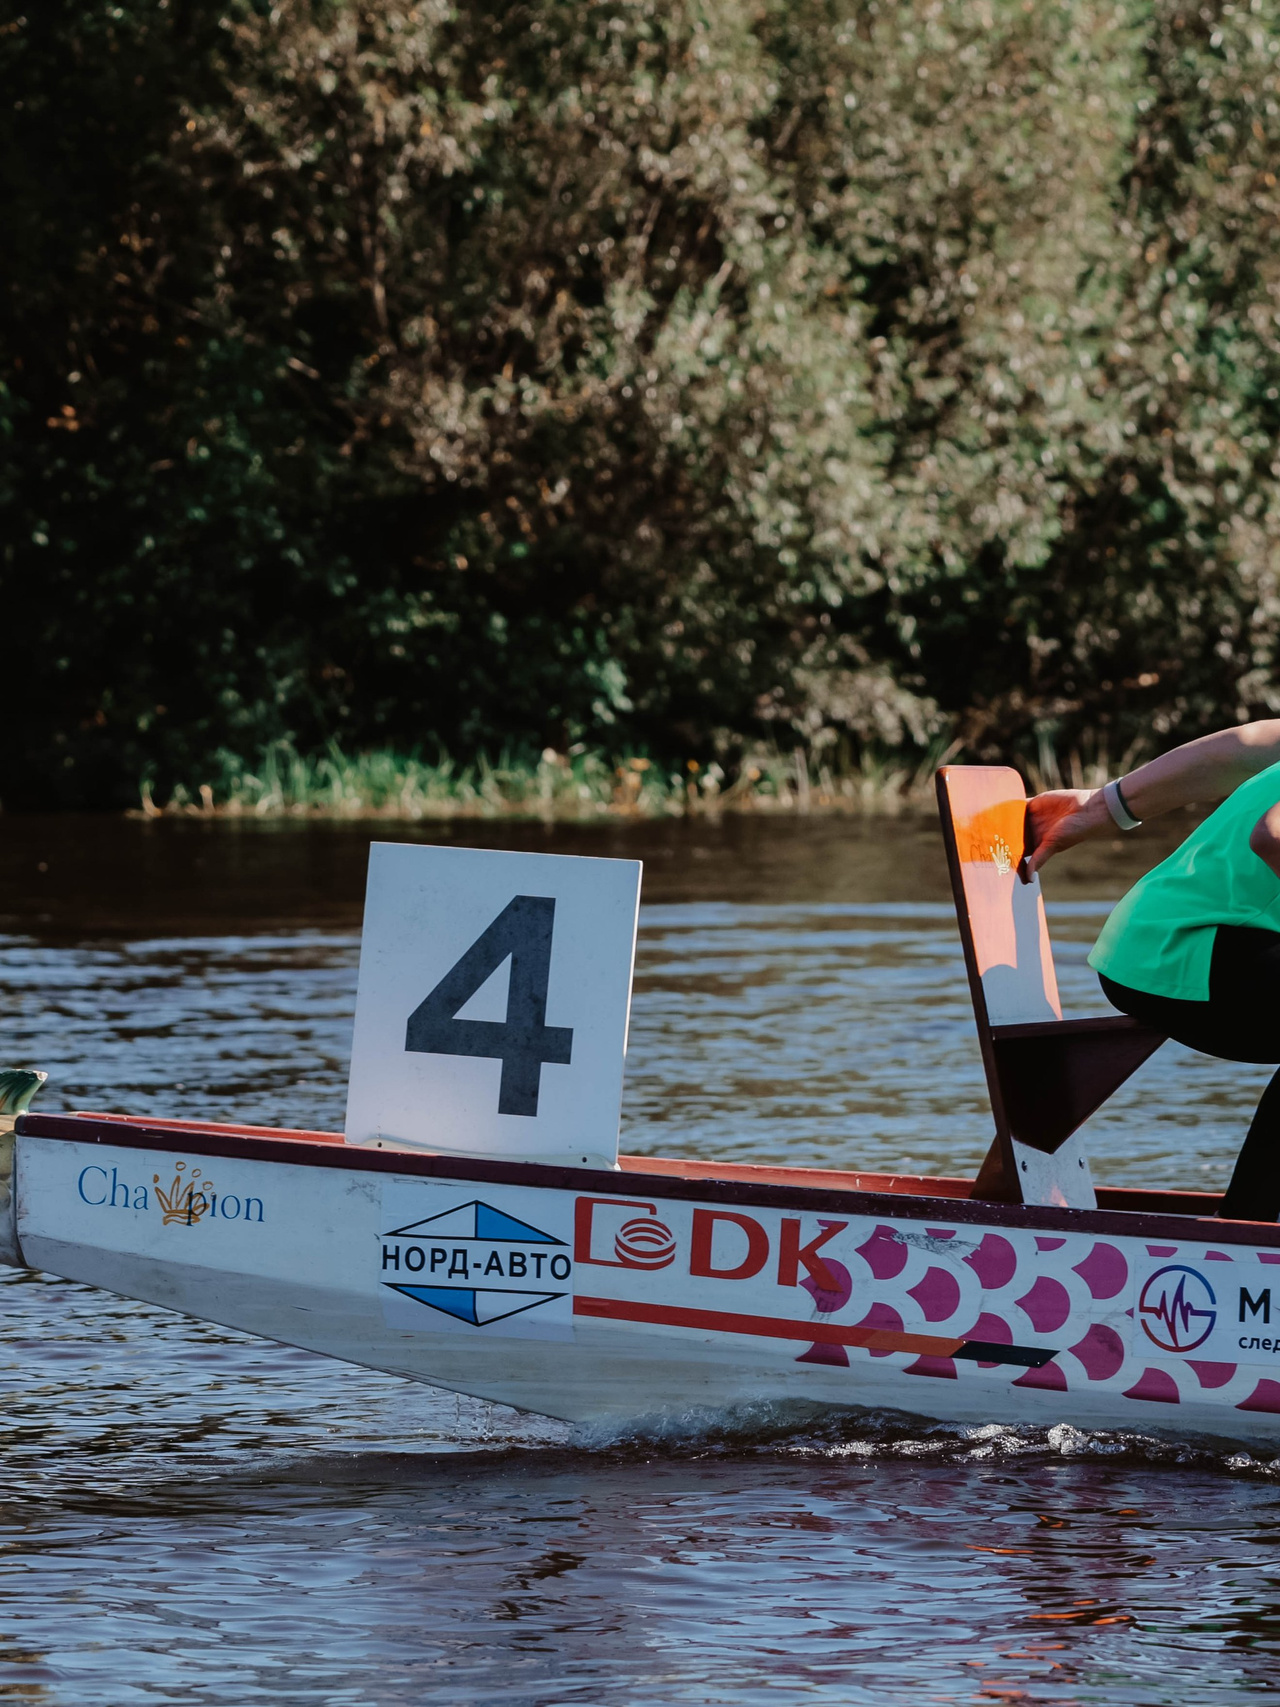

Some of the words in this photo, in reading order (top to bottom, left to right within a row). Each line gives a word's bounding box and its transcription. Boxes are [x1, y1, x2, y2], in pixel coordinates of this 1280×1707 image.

[404, 894, 574, 1118] 4
[78, 1163, 265, 1227] Chapion
[382, 1244, 572, 1281] НОРД-АВТО
